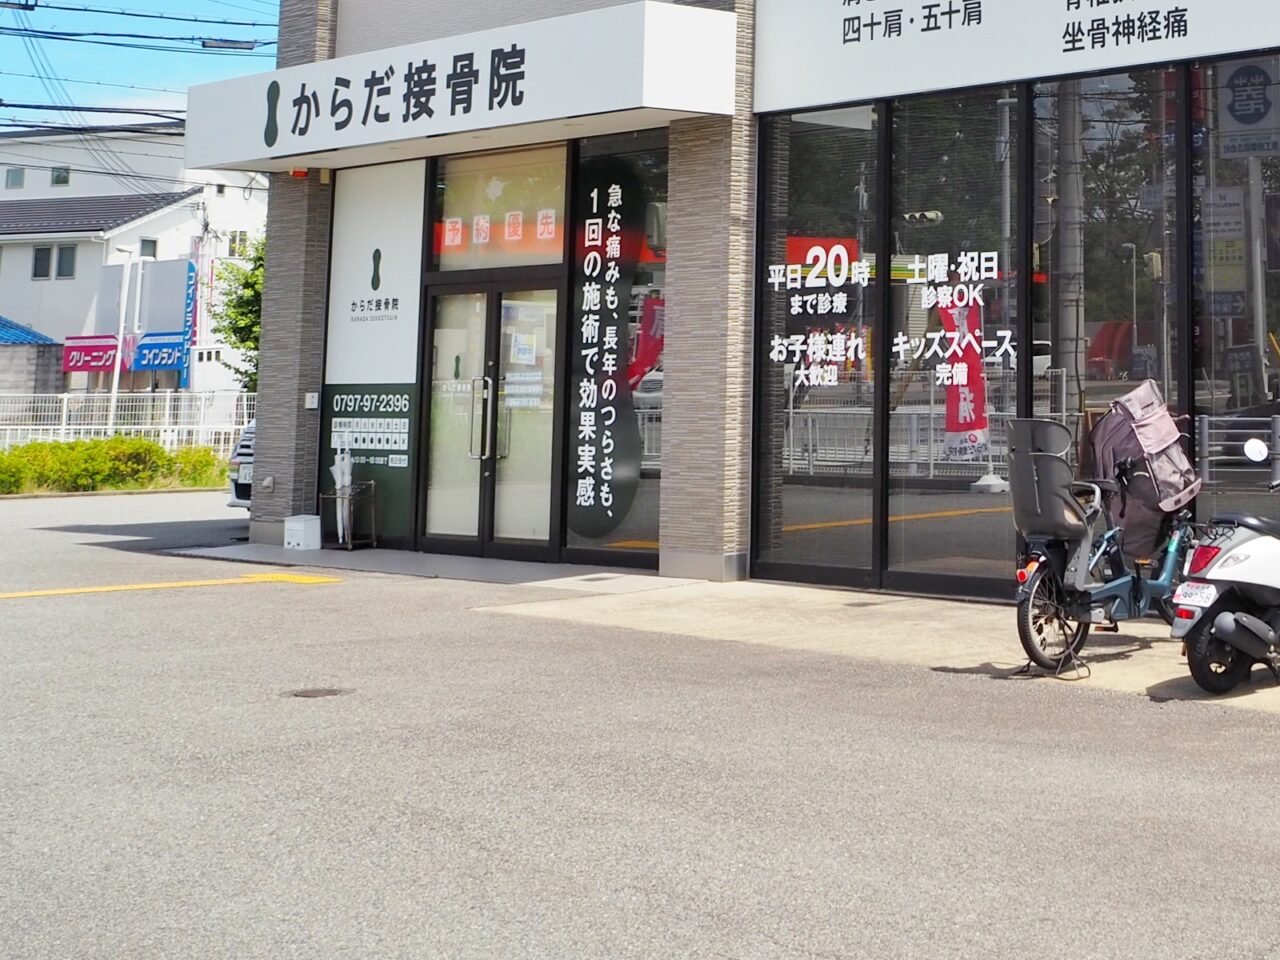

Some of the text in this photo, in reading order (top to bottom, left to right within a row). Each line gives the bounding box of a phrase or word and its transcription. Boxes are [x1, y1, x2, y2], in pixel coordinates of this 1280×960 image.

[1062, 7, 1189, 53] 坐骨神経痛
[290, 43, 527, 137] からだ接骨院
[768, 245, 870, 291] 平日20時
[906, 251, 999, 284] 土曜・祝日
[790, 292, 848, 315] まで診療
[921, 283, 984, 309] 診察OK
[69, 351, 116, 367] クリーニング
[576, 187, 603, 507] 1回の施術で効果実感
[599, 183, 624, 519] 急な痛みも、長年のつらさも、
[769, 332, 866, 364] お子様連れ
[892, 330, 1017, 361] キッズスペース
[795, 364, 839, 387] 大歓迎
[935, 364, 968, 386] 完備
[333, 394, 410, 412] 0797-97-2396
